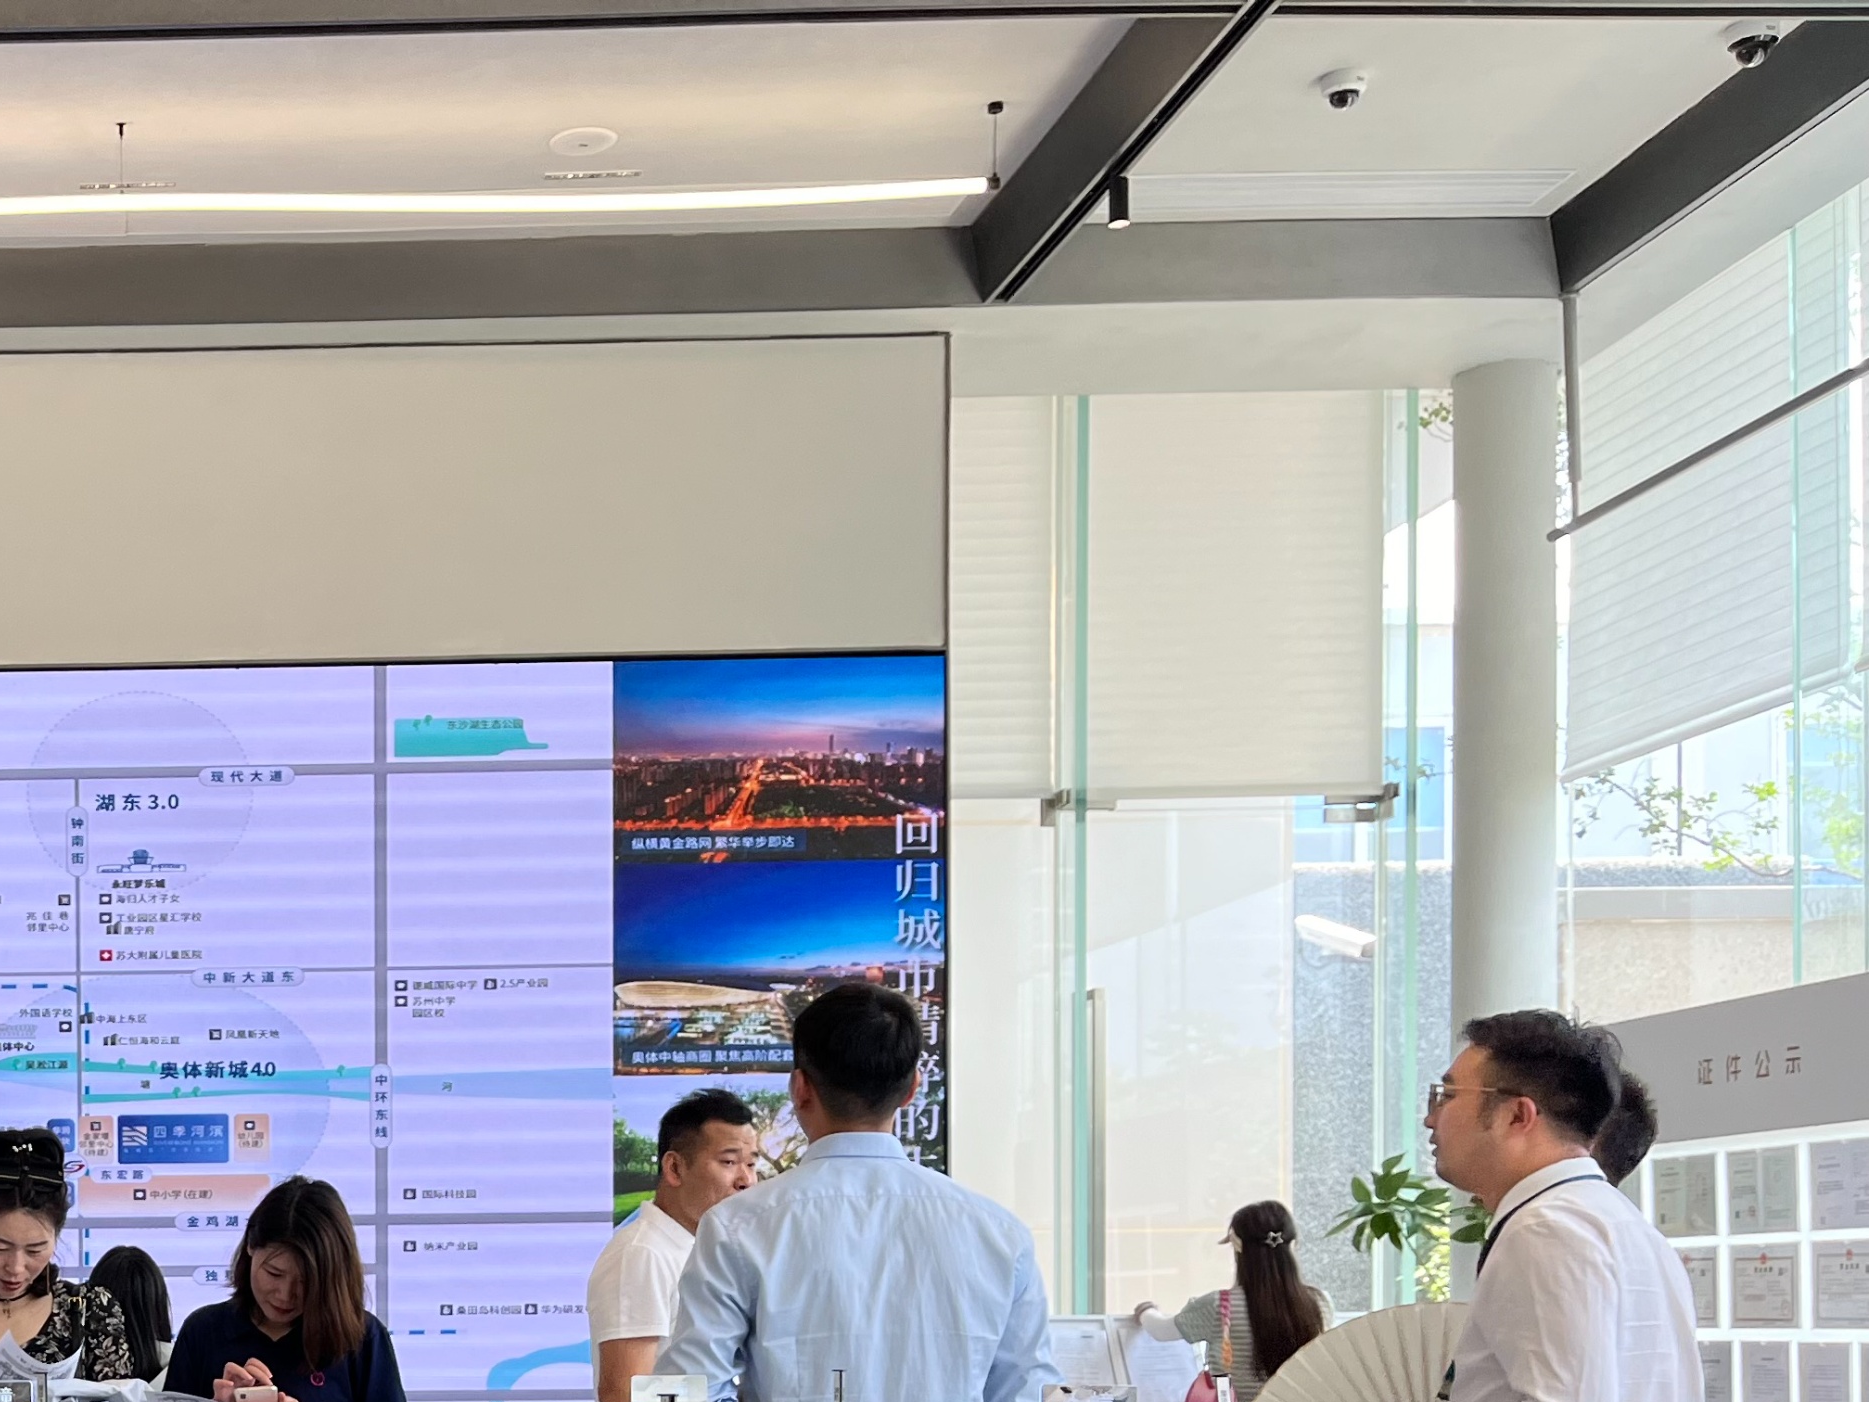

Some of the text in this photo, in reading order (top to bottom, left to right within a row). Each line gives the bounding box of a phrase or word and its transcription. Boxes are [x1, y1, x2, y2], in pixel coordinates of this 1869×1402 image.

[210, 770, 284, 783] 现代大道
[71, 818, 84, 864] 钟南街
[116, 894, 180, 904] 海归人才子女
[116, 912, 202, 922] 工业园区星汇学校
[27, 923, 69, 932] 邻里中心
[116, 950, 202, 960] 苏大附属儿童医院
[203, 971, 295, 983] 中新大道东
[413, 996, 456, 1006] 苏州中学
[19, 1008, 73, 1018] 外国语学校
[96, 1014, 147, 1024] 中海上东区
[1697, 1046, 1802, 1085] 证件公示
[375, 1074, 388, 1138] 中环东线
[153, 1125, 224, 1138] 四季河滨
[101, 1170, 144, 1180] 东宏路
[187, 1216, 249, 1227] 金鸡湖
[541, 1304, 589, 1314] 华为研发
